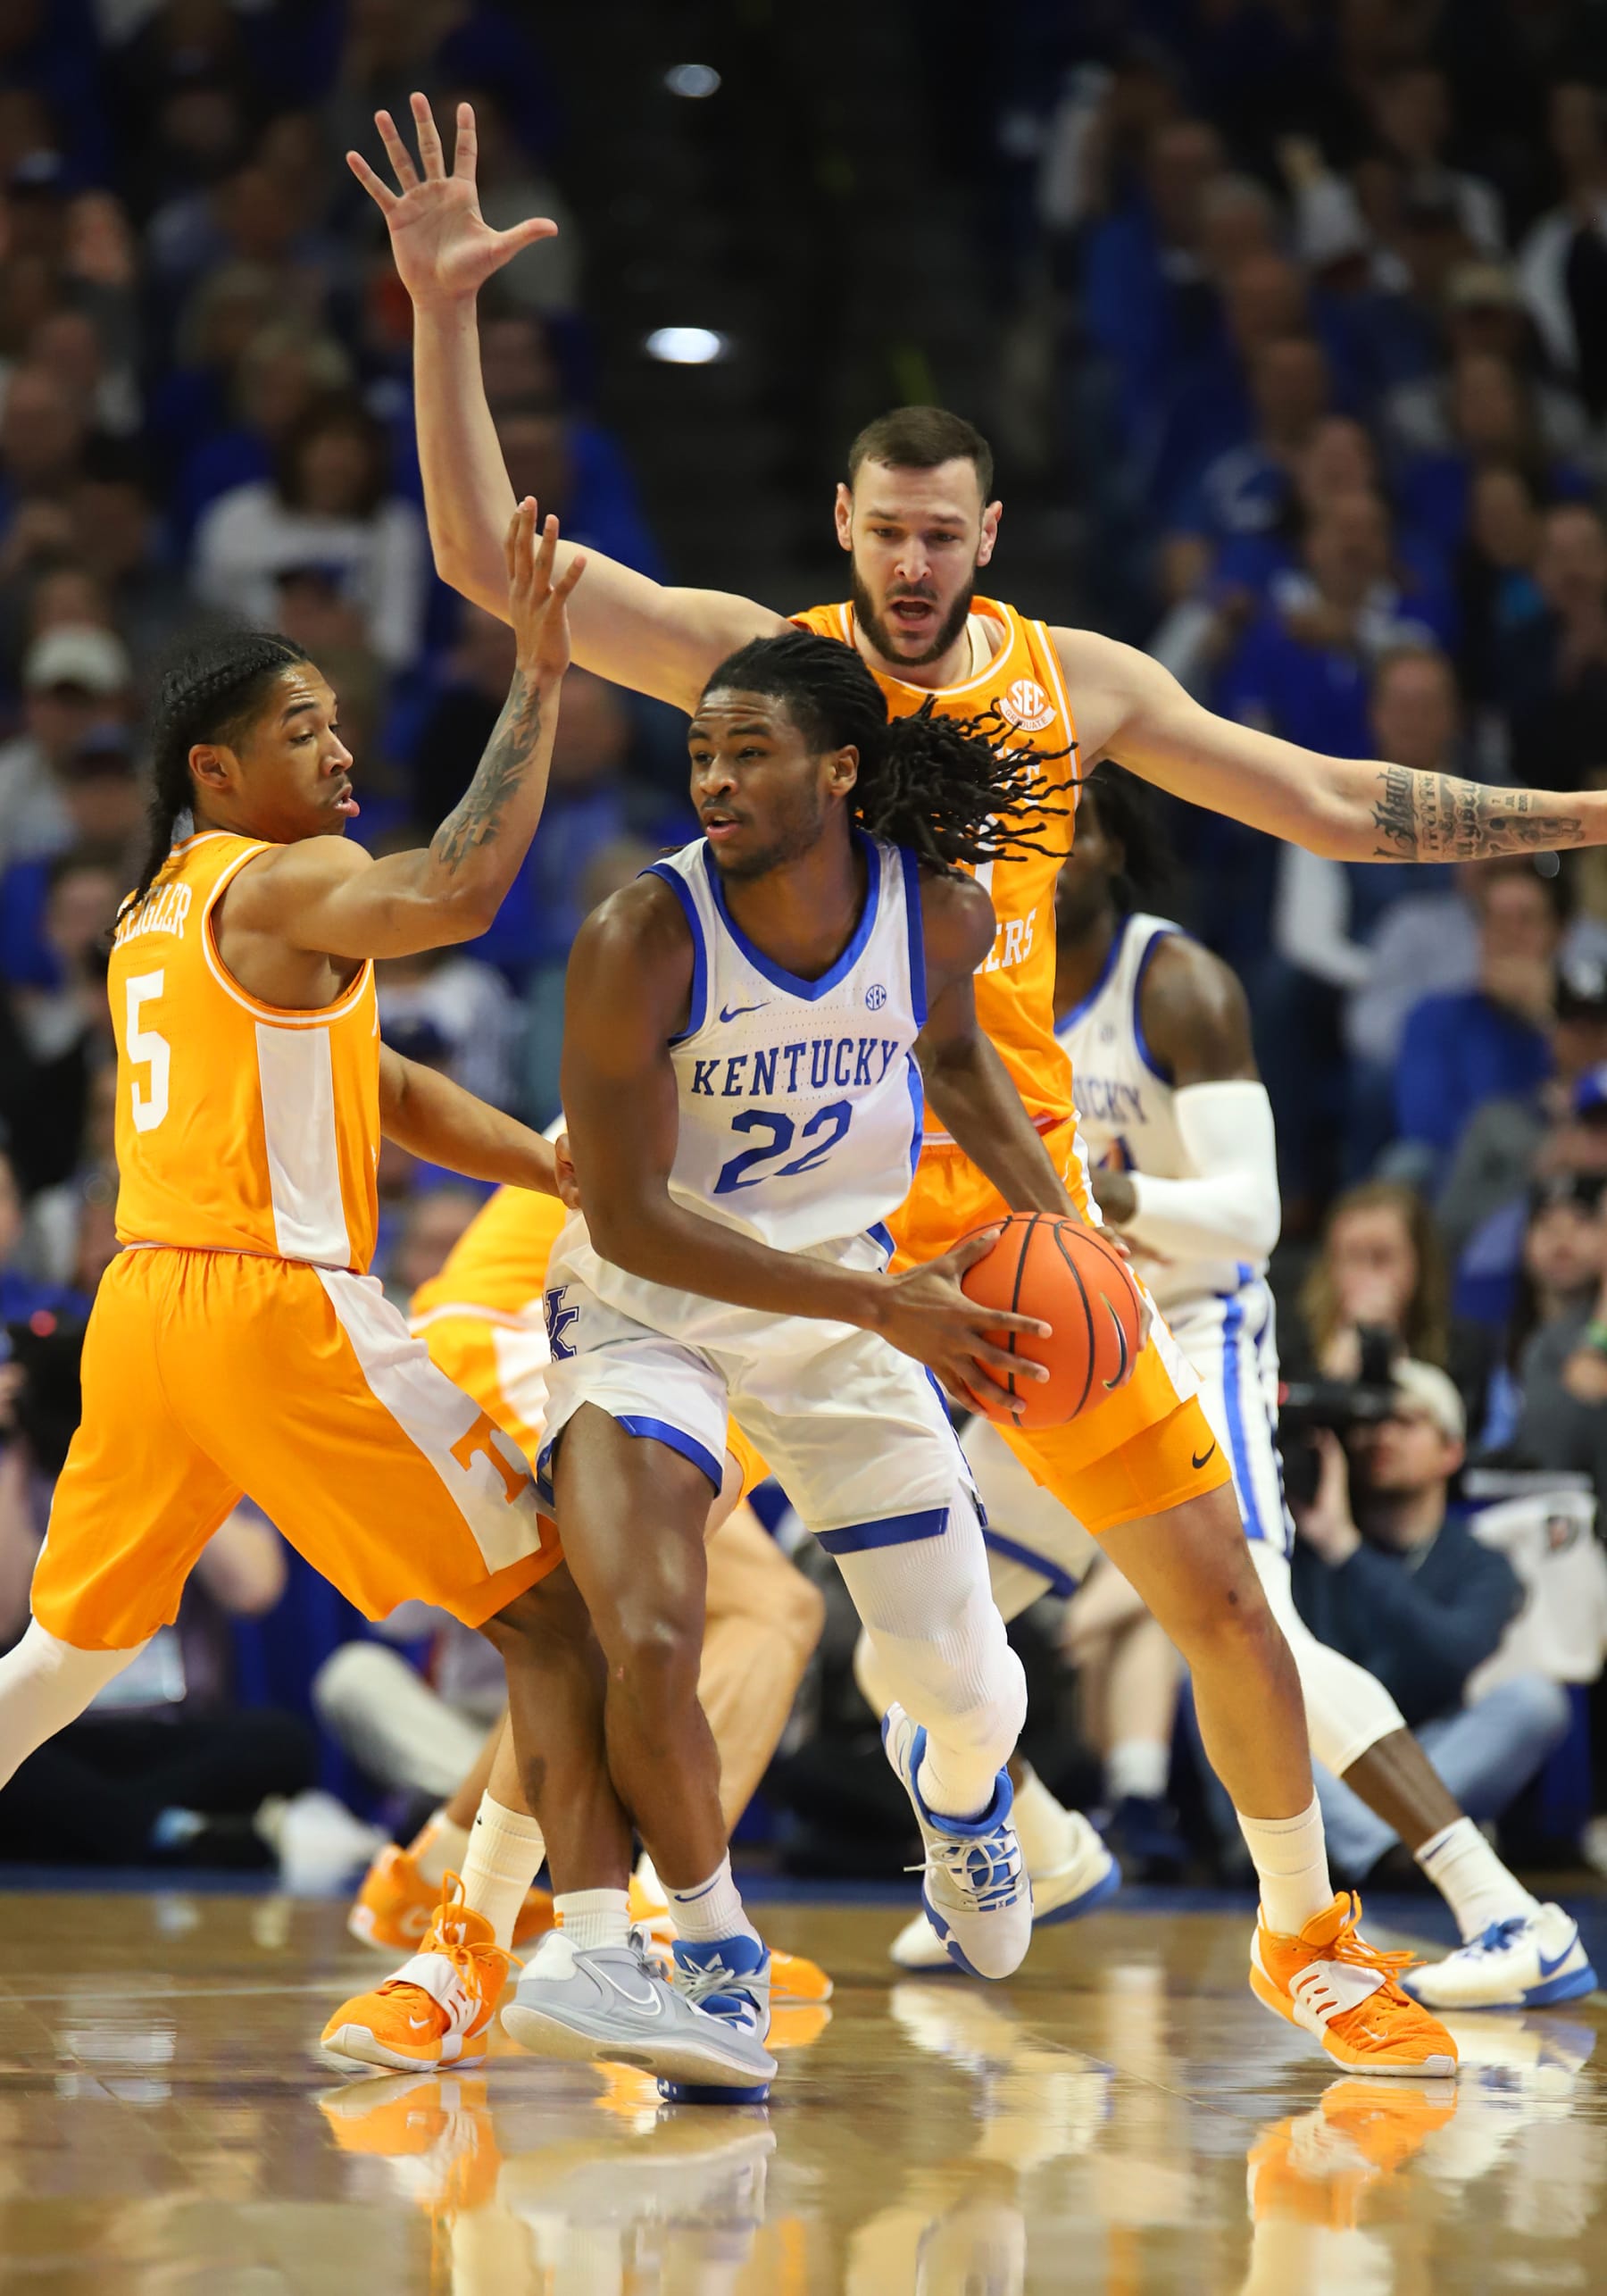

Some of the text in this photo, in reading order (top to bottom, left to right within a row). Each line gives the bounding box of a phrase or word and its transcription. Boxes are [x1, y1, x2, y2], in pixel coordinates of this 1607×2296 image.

[1005, 709, 1050, 730] GRDUATE
[1011, 680, 1045, 716] SEC
[865, 983, 887, 1011] SEC
[126, 968, 171, 1133] 5
[691, 1038, 899, 1097] KENTUCKY
[713, 1099, 853, 1194] 22
